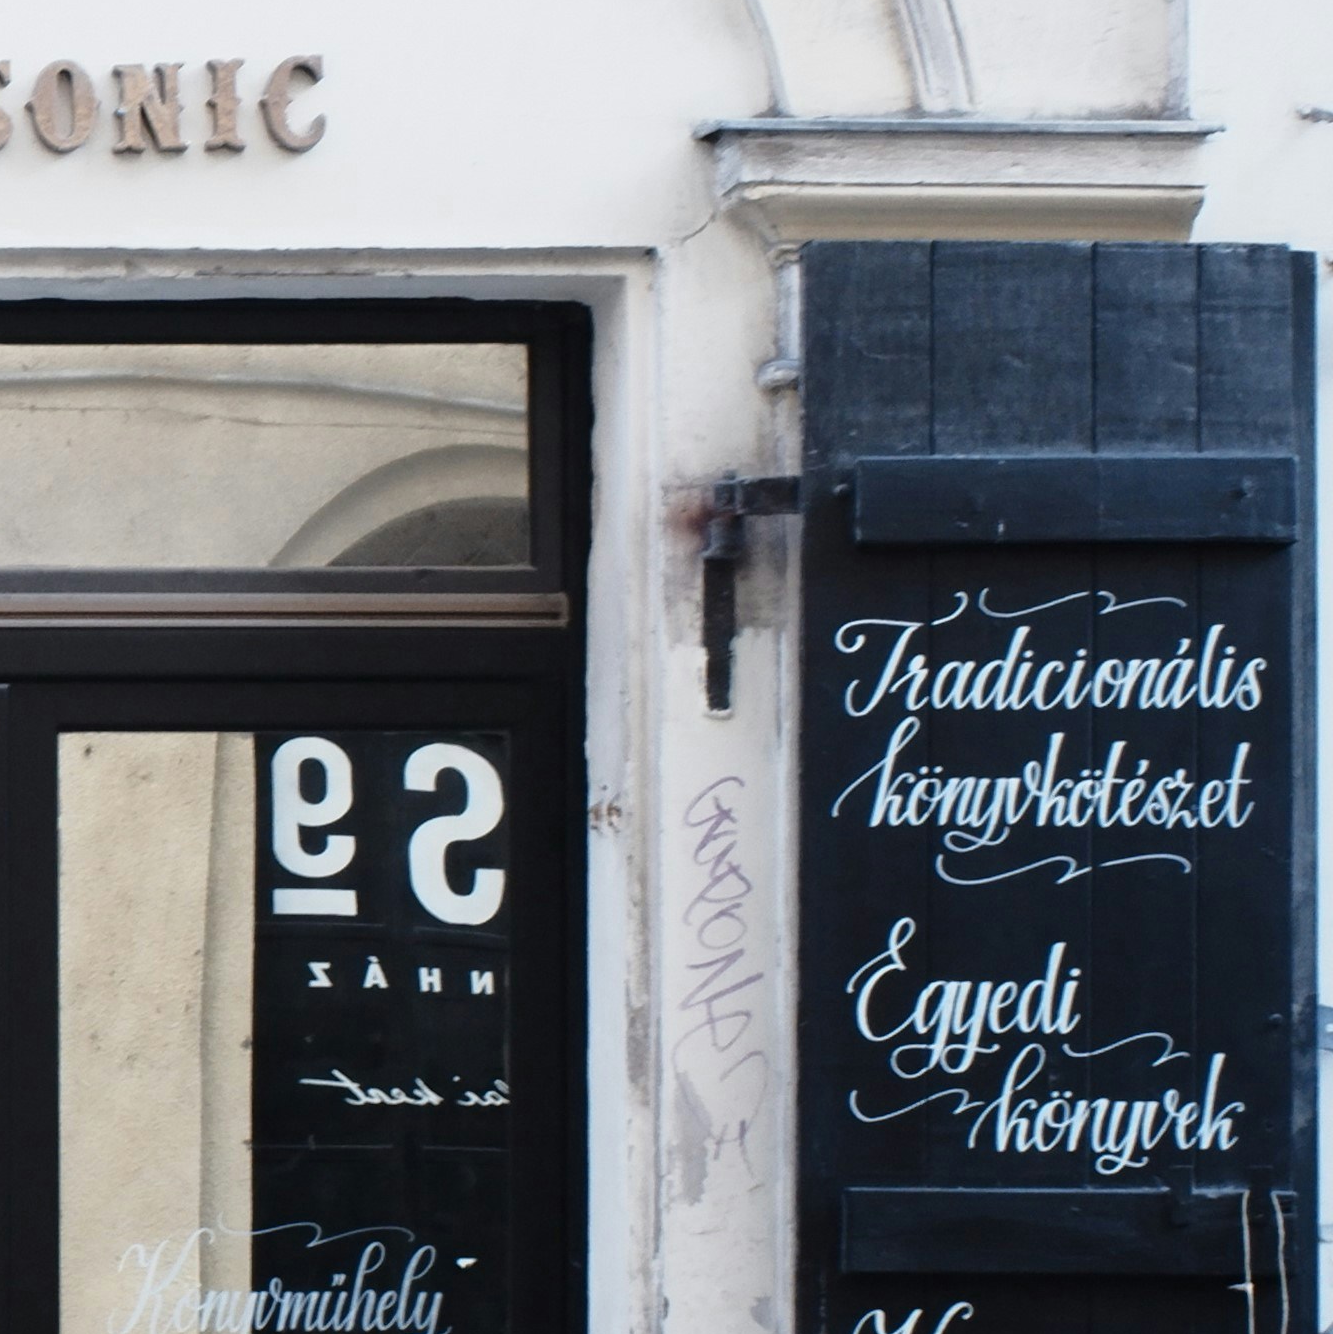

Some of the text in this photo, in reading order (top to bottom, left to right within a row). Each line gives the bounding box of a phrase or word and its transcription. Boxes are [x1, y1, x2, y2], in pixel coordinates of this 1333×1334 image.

[835, 591, 1268, 718] Tradicionális
[833, 715, 1256, 852] könyvkötészet
[846, 917, 1082, 1079] Egyedi
[968, 1043, 1246, 1175] könyvek
